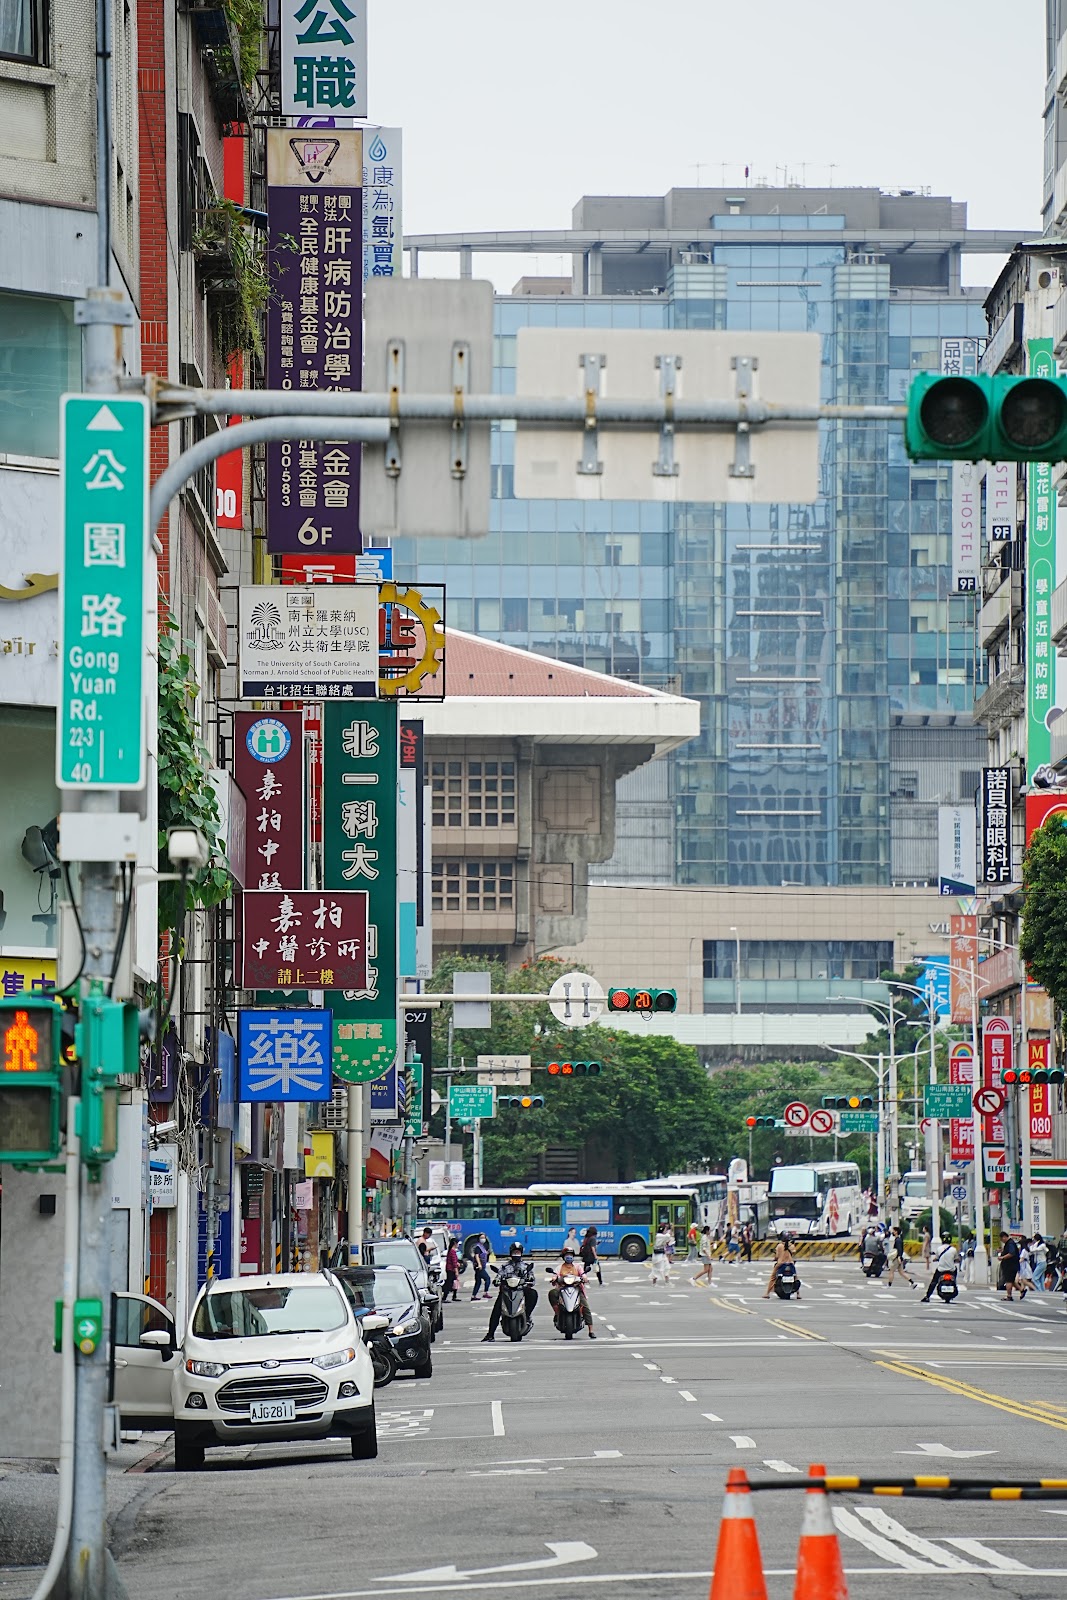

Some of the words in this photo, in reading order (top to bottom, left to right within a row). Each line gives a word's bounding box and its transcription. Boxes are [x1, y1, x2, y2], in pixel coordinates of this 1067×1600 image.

[297, 517, 333, 545] 6F
[961, 493, 973, 562] HOSTEL
[993, 526, 1010, 540] 9F
[81, 448, 128, 639] 公園路
[959, 578, 975, 590] 9F
[288, 609, 356, 623] 南卡羅萊納
[288, 639, 371, 653] 公共衛生學院
[1035, 578, 1049, 701] 學童近視防控
[69, 645, 119, 675] Gong
[270, 660, 303, 669] University
[69, 671, 117, 695] Yuan
[263, 684, 354, 697] 台北招生聯絡處
[69, 698, 103, 721] Rd.
[70, 763, 93, 783] 40
[986, 769, 1008, 867] 諾貝爾眼科
[986, 866, 1010, 882] 5F
[270, 893, 343, 934] 嘉柏
[251, 934, 361, 963] 中醫診所
[276, 967, 335, 986] 請上二樓
[635, 992, 650, 1008] 20
[246, 1018, 325, 1094] 藥
[1031, 1117, 1051, 1134] 080
[251, 1405, 293, 1420] AJG-2811
